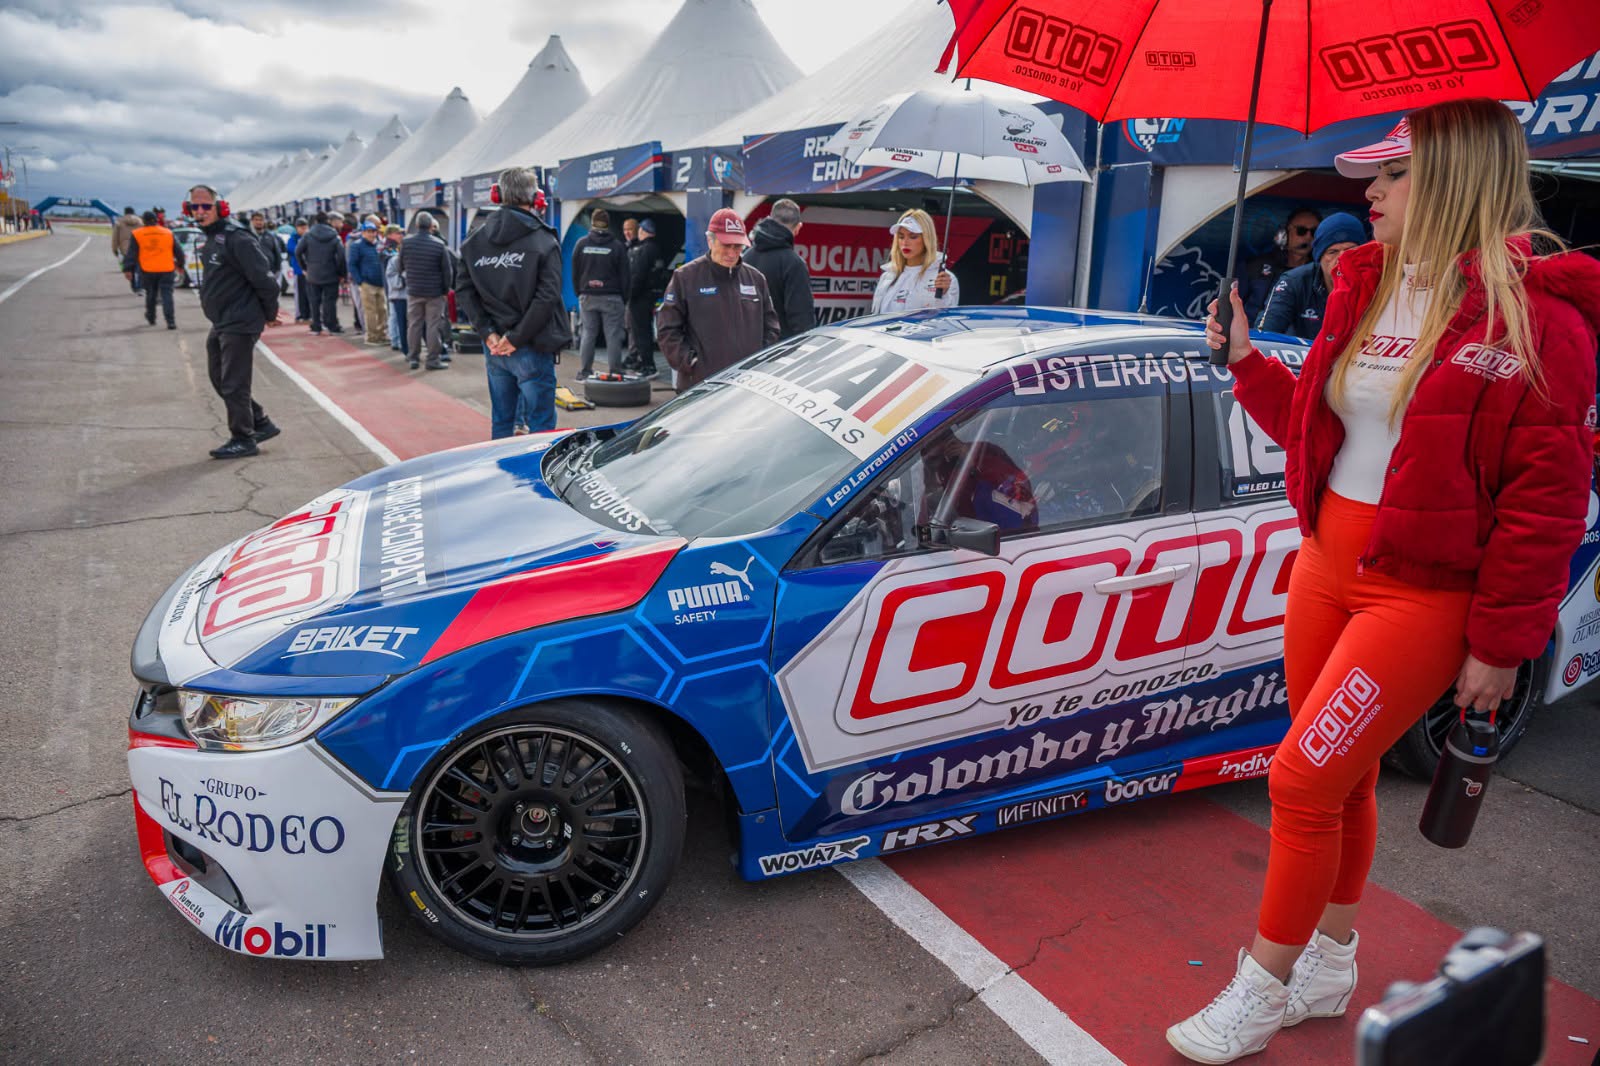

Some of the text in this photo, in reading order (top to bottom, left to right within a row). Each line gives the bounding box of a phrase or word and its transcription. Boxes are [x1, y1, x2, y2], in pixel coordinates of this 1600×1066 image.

[587, 174, 618, 191] BARRIO
[589, 157, 615, 174] JORGE
[676, 156, 692, 183] 2
[1046, 351, 1209, 391] STORAGE
[1451, 343, 1527, 378] COTO
[825, 484, 851, 508] Leo
[848, 442, 899, 488] Larrauri
[1250, 482, 1270, 492] LEO
[667, 580, 743, 611] PUMA
[674, 610, 717, 625] SAFETY
[286, 625, 419, 653] BRIKET
[1007, 664, 1219, 729] Yo te conozco.
[1299, 667, 1380, 767] COTO
[841, 731, 1092, 815] Colombo
[1096, 718, 1135, 763] y
[1336, 745, 1348, 757] Yo
[206, 778, 257, 800] GRUPO
[159, 776, 192, 831] EL
[194, 794, 345, 855] RODEO
[998, 792, 1085, 826] INFINITY
[882, 815, 978, 850] HRX
[215, 909, 326, 957] Mobil
